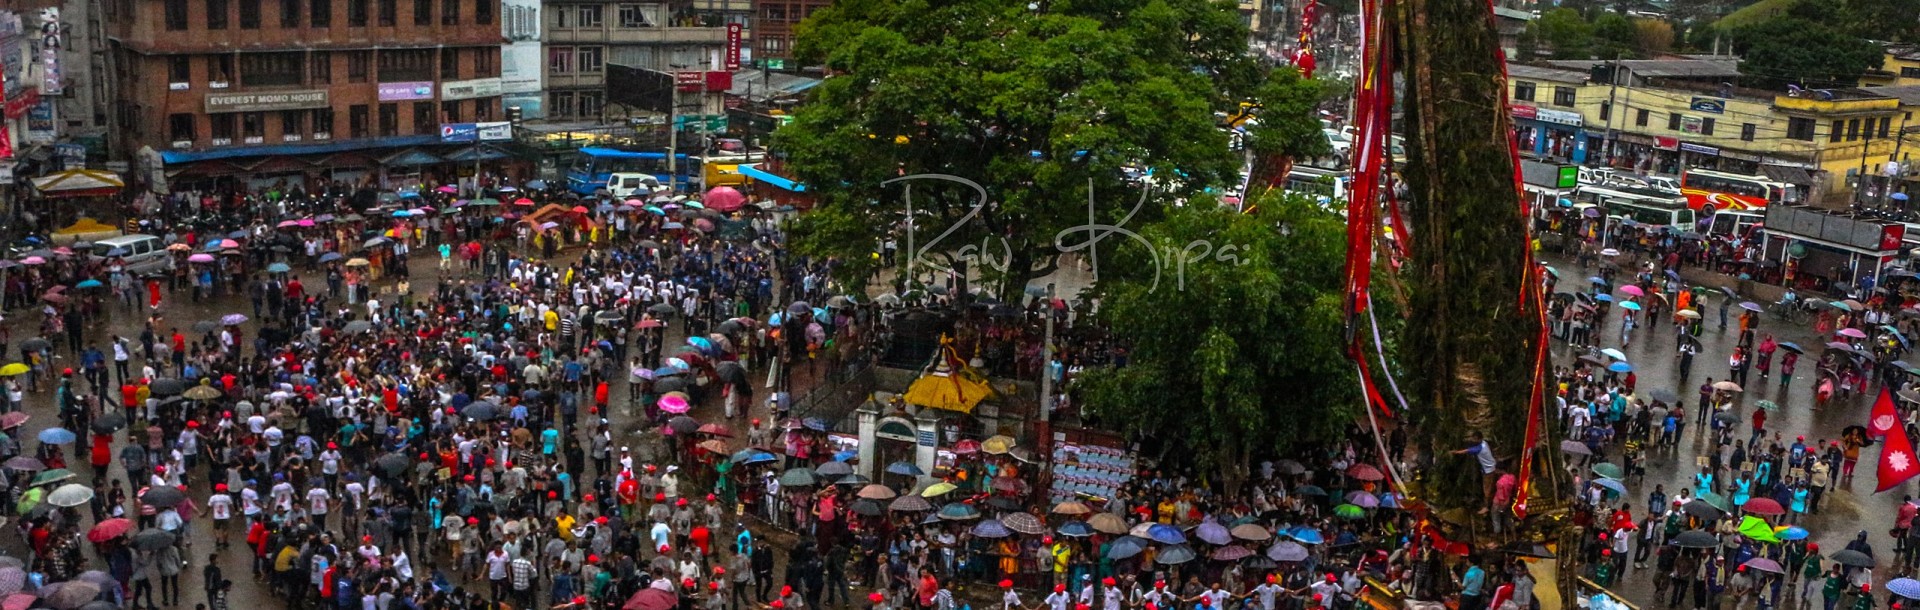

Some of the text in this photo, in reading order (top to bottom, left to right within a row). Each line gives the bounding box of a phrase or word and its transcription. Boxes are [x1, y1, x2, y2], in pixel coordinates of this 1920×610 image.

[210, 93, 324, 105] EVEREST MOMO HOUSE
